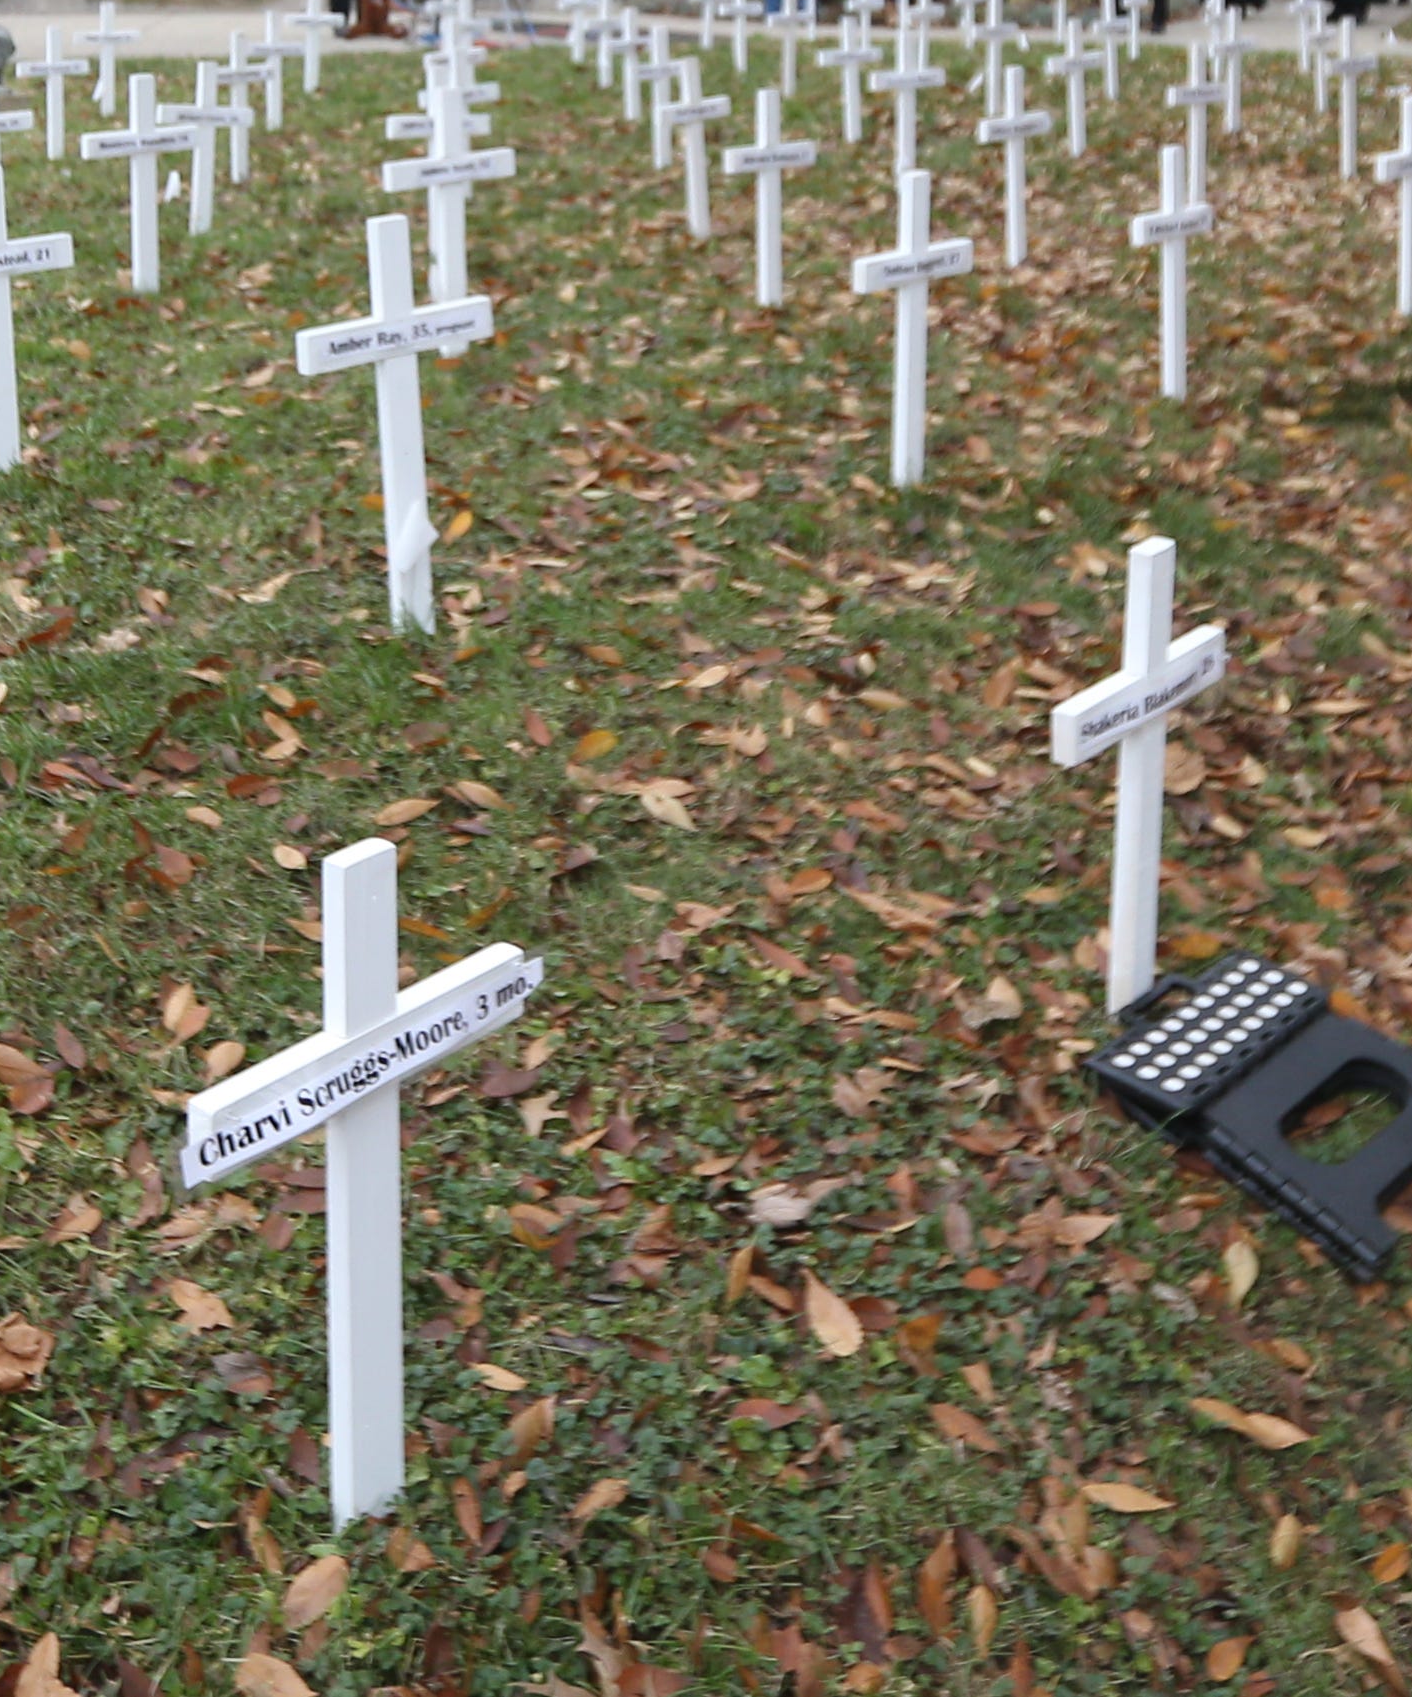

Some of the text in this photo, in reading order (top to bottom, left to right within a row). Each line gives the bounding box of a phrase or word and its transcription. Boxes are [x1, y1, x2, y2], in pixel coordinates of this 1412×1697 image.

[198, 976, 534, 1167] Charvi Scruggs-Moore, 3 mo.
